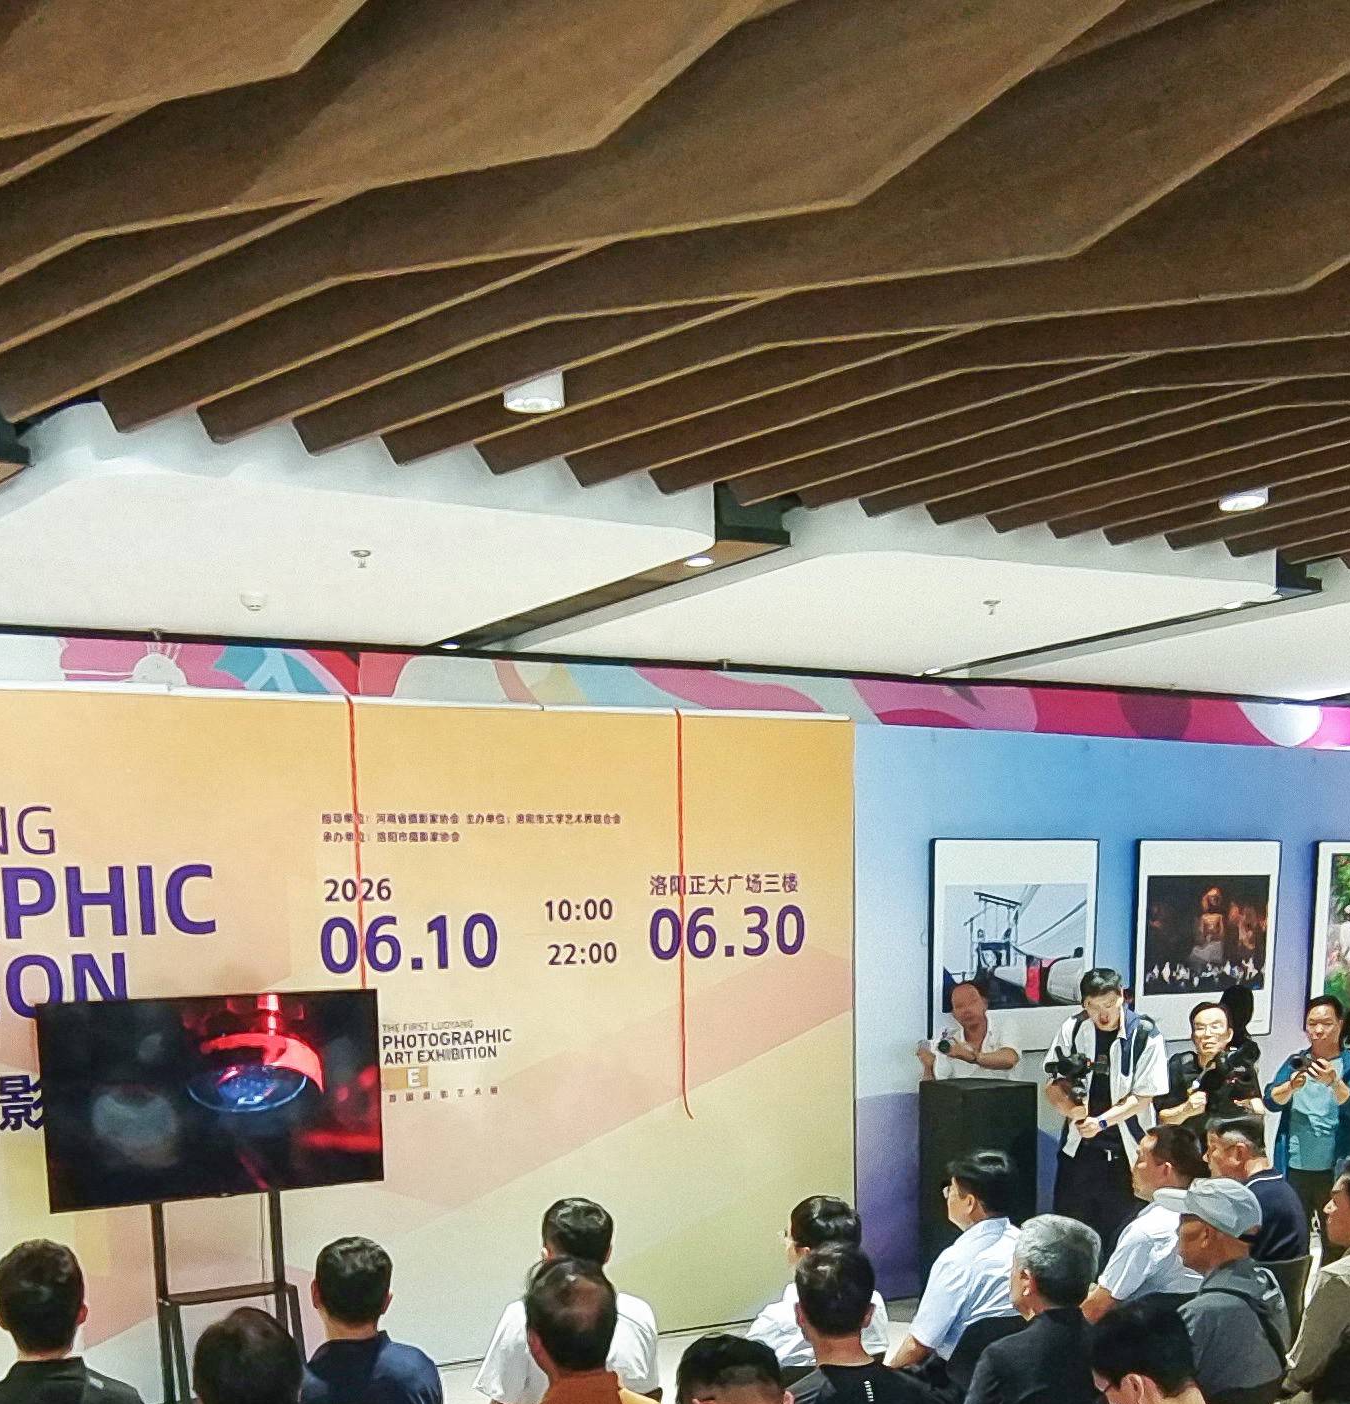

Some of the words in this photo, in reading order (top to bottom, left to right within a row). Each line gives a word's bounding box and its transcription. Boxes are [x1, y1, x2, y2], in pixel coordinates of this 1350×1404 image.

[324, 878, 392, 902] 2026
[649, 872, 799, 897] 洛阳正大广场三楼
[545, 899, 614, 922] 10:00
[320, 912, 498, 974] 06.10
[649, 904, 806, 960] 06.30
[548, 942, 618, 966] 22:00
[382, 1028, 512, 1050] PHOTOGRAPHIC
[384, 1051, 413, 1065] ART
[417, 1045, 498, 1063] EXHIBITION
